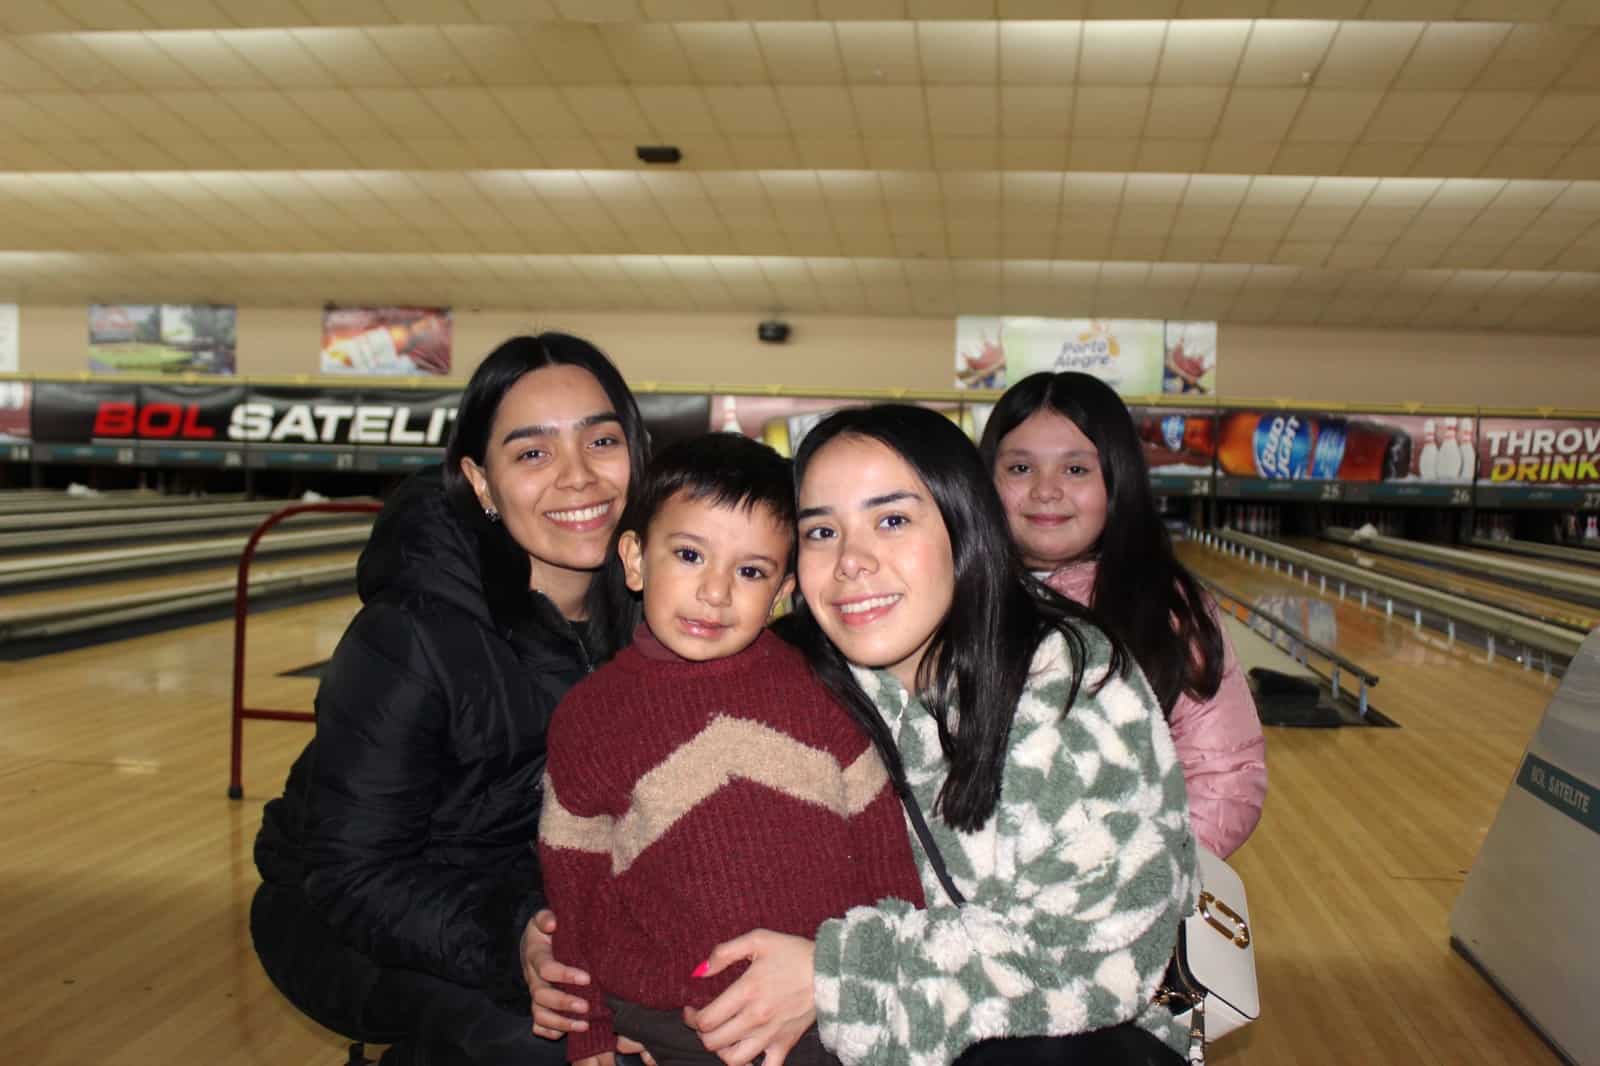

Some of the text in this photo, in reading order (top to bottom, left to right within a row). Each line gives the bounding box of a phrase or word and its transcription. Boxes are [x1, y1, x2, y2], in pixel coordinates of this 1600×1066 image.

[93, 401, 459, 444] BOL SATELI
[1262, 416, 1285, 471] BUD
[1548, 775, 1591, 814] SATELITE
